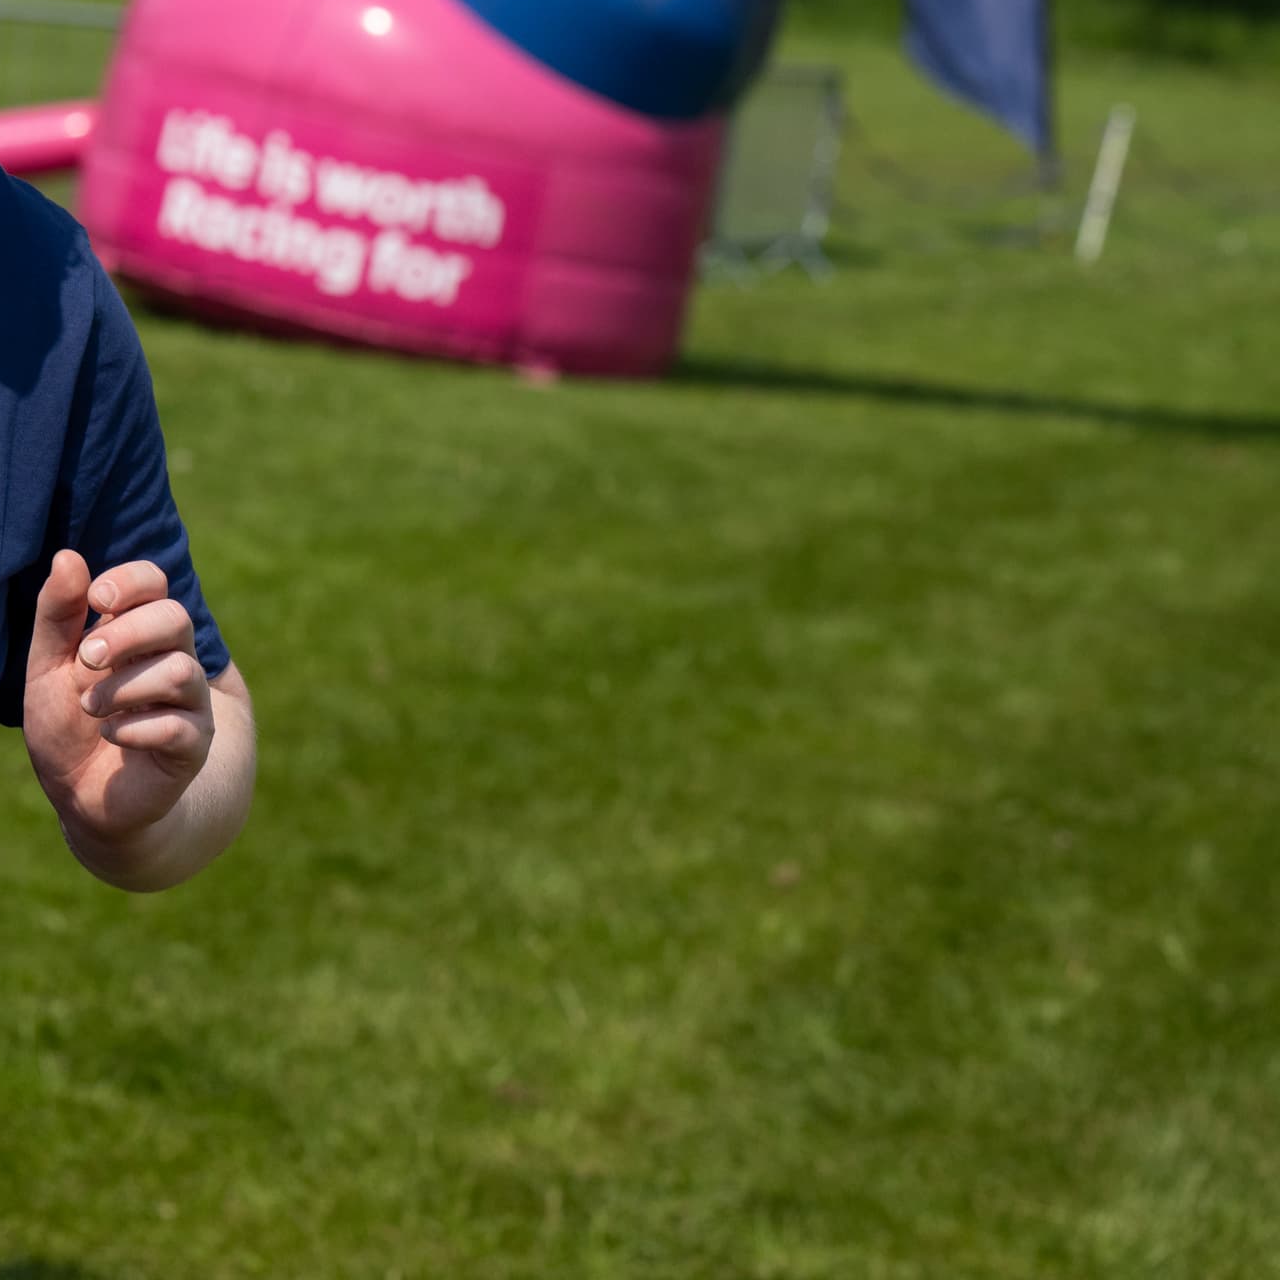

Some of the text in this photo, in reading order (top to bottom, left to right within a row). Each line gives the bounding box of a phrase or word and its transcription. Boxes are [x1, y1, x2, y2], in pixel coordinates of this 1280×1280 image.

[156, 108, 506, 249] Life is worth
[157, 176, 472, 308] Racing for
